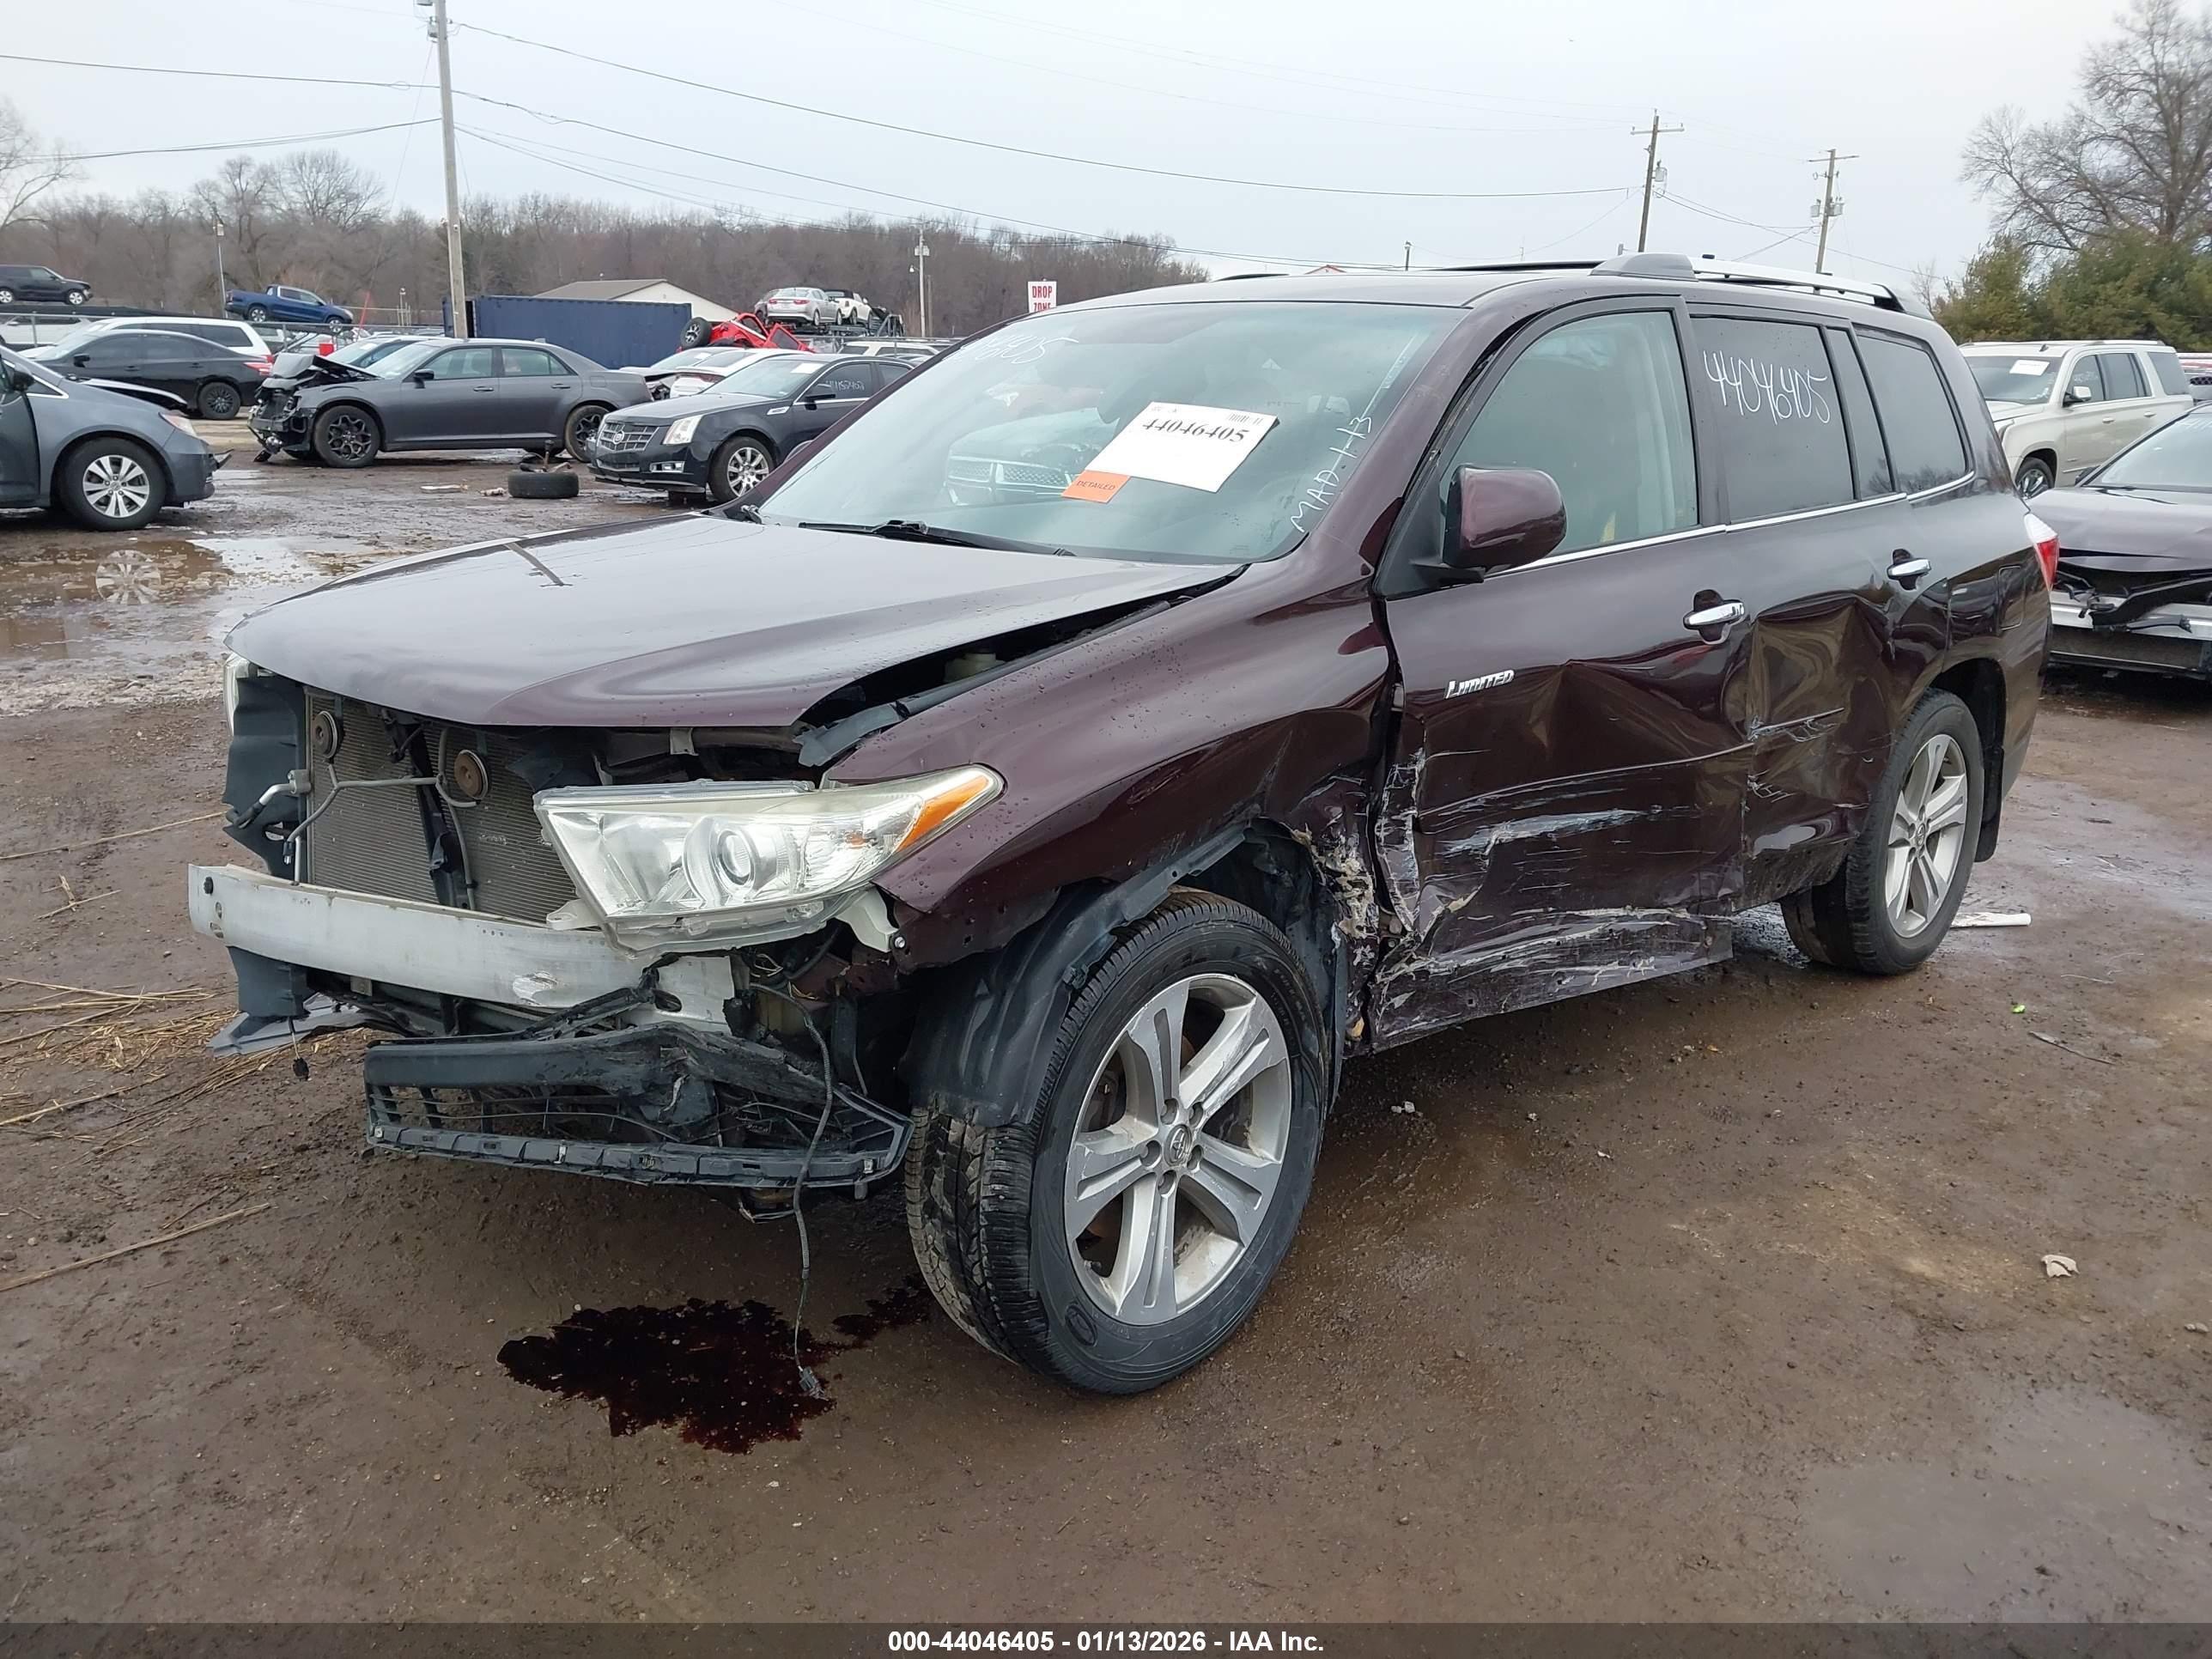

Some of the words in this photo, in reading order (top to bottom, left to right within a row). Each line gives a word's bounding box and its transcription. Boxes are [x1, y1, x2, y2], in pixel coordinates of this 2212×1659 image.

[1032, 285, 1053, 298] DROP
[1703, 349, 1831, 426] 44046405
[1143, 418, 1249, 443] 44046405
[1076, 479, 1116, 491] DETAILED
[1290, 469, 1340, 533] MAD
[1444, 669, 1515, 700] LIMITED
